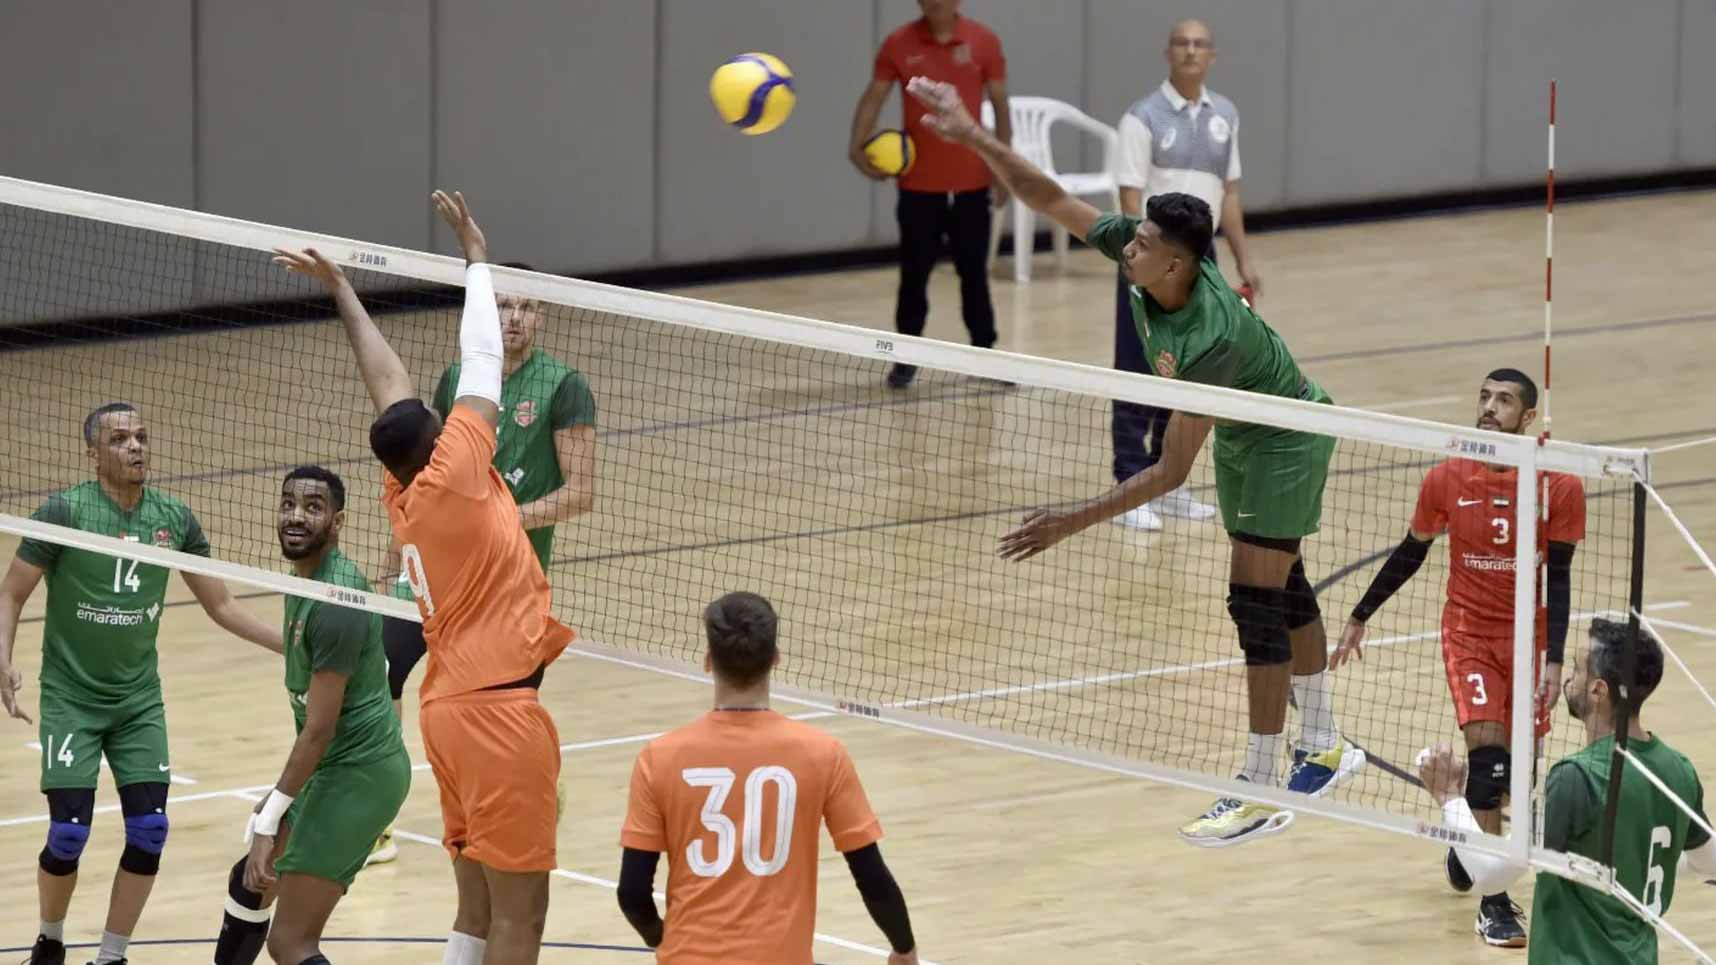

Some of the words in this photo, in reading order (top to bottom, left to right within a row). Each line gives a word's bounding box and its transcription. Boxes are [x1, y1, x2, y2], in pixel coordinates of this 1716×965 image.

[876, 339, 894, 351] FIVB
[1491, 517, 1510, 544] 3
[113, 557, 141, 593] 14
[402, 543, 434, 616] 9
[76, 608, 144, 626] emaratech
[1467, 673, 1488, 705] 3
[47, 733, 74, 769] 14
[682, 765, 797, 878] 30
[1642, 825, 1672, 918] 6
